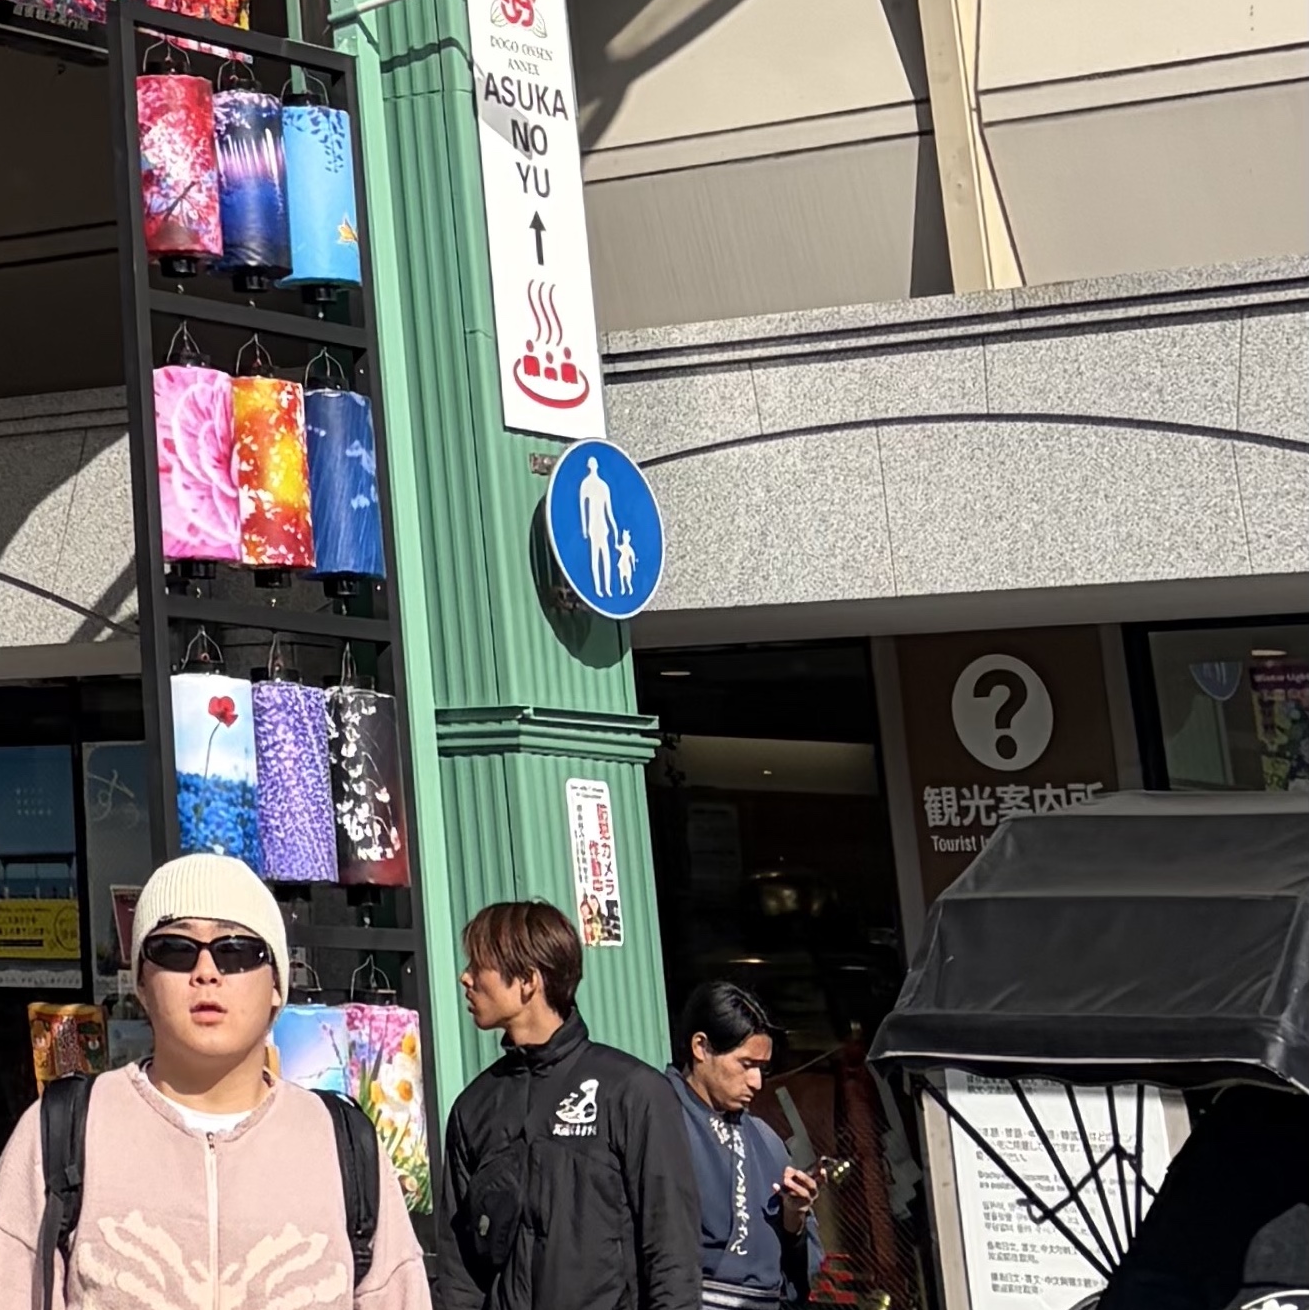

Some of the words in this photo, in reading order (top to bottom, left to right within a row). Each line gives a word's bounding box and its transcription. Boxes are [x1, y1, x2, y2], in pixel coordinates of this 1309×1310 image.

[490, 35, 519, 53] DOGO
[508, 58, 540, 76] ANNEX
[484, 72, 568, 121] ASUKA
[511, 119, 548, 156] NO
[515, 161, 551, 198] YU
[930, 835, 977, 853] Tourist
